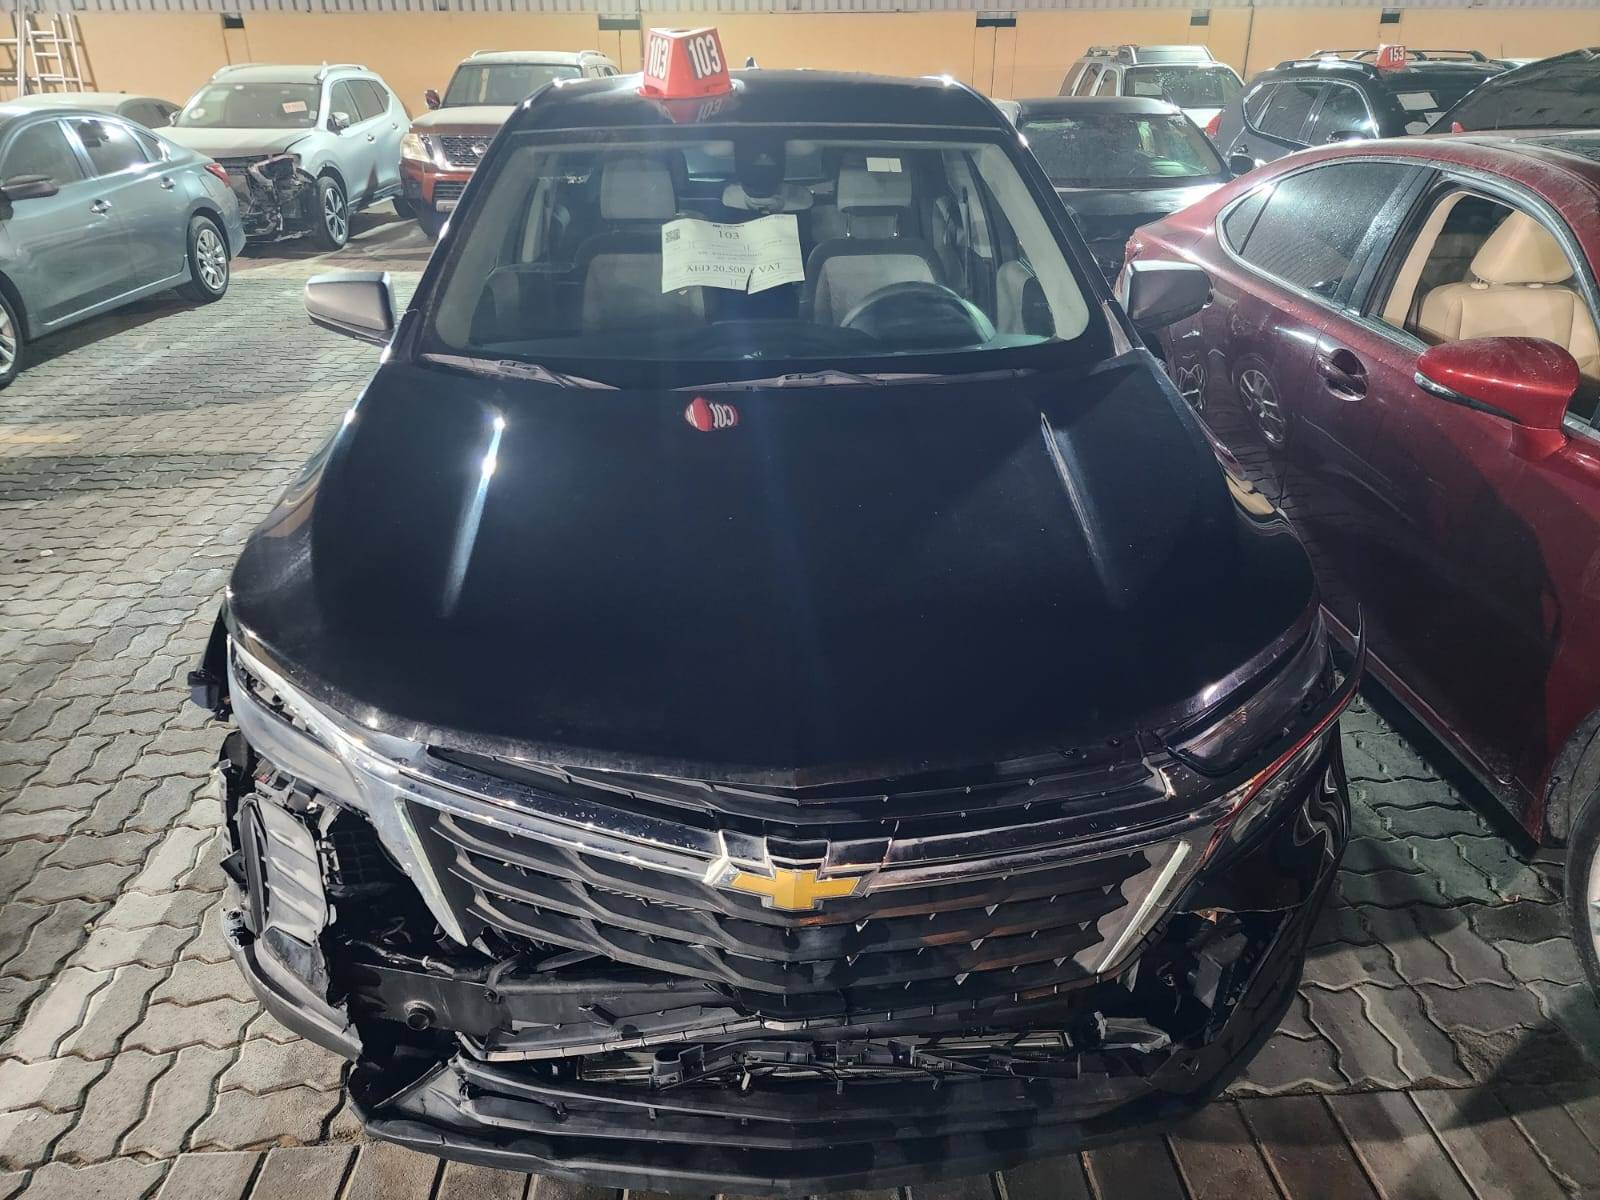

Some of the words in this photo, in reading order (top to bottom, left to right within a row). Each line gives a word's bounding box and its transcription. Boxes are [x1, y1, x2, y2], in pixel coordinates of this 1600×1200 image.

[648, 36, 669, 80] 103
[688, 34, 722, 79] 103
[1389, 46, 1405, 62] 153
[719, 230, 740, 240] 103
